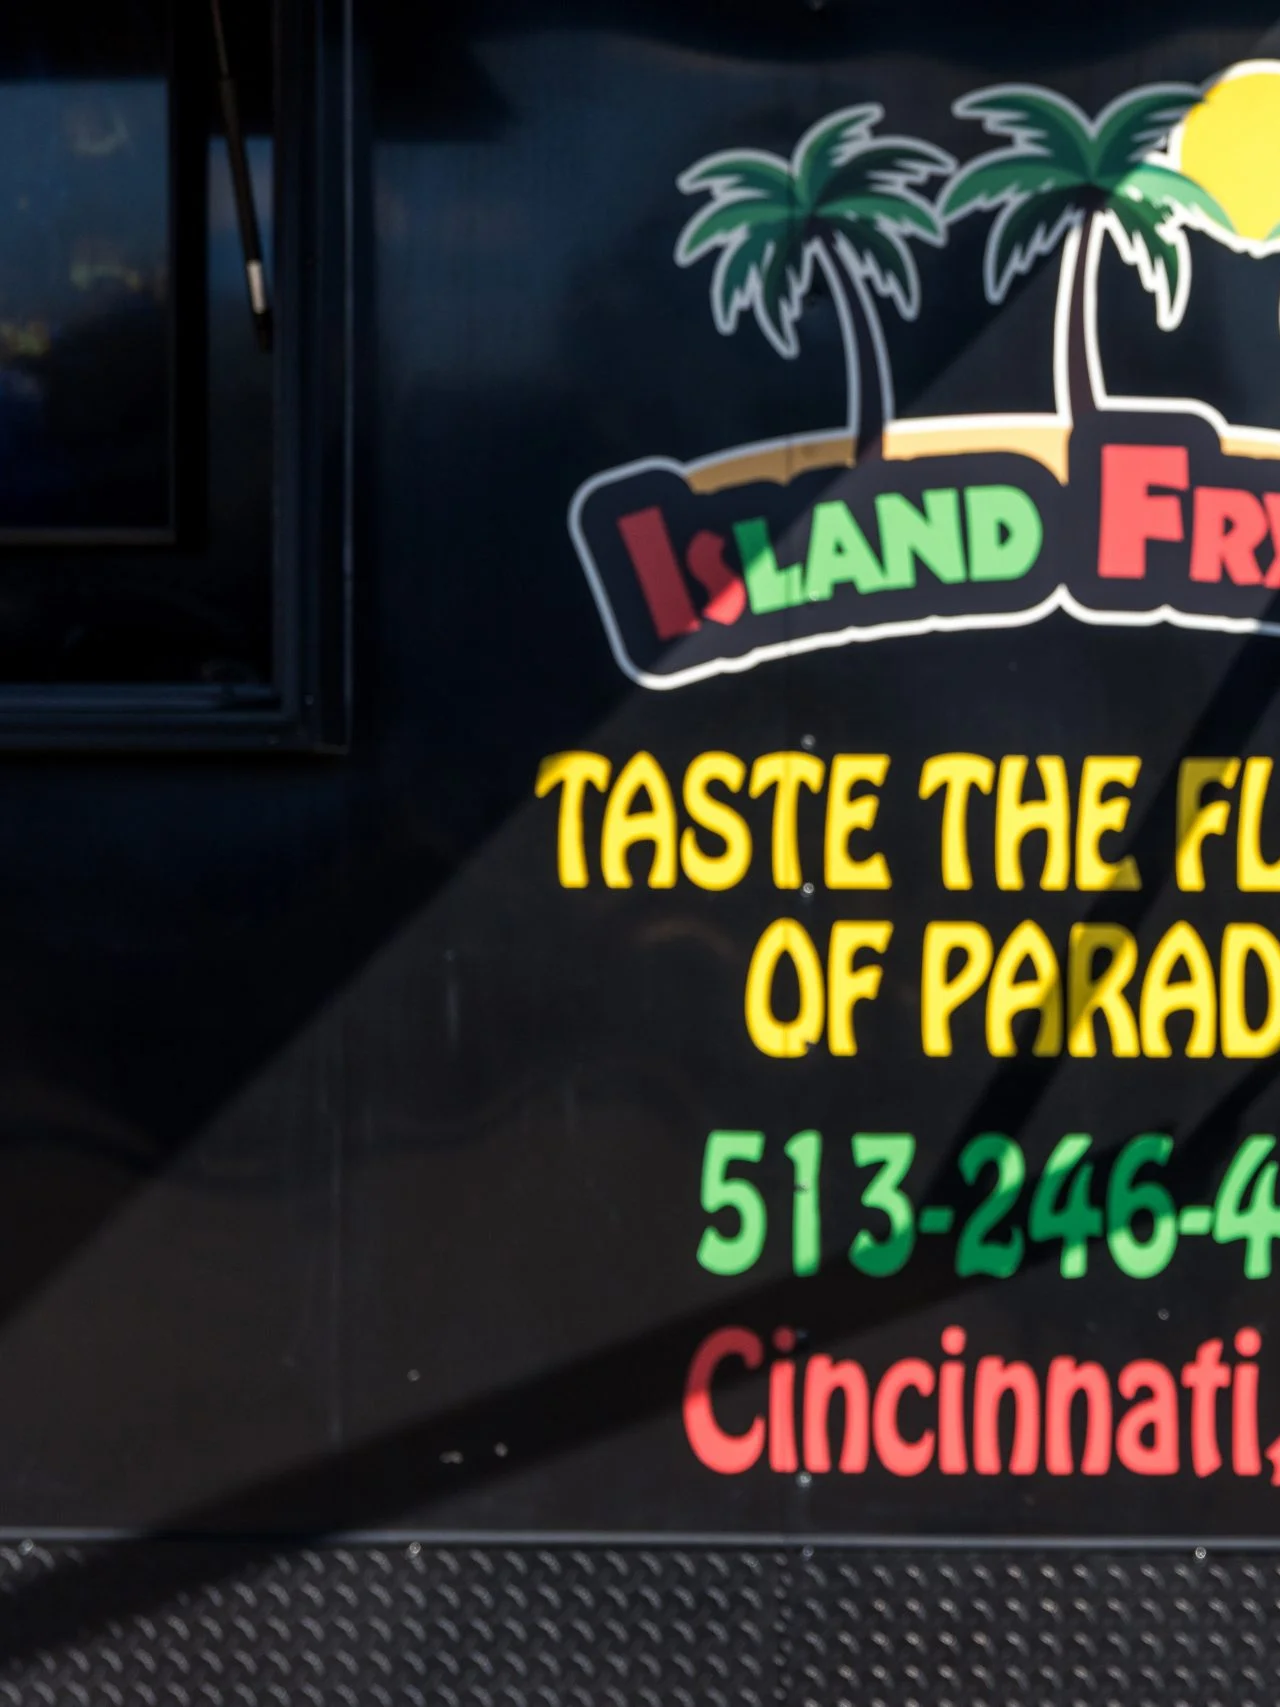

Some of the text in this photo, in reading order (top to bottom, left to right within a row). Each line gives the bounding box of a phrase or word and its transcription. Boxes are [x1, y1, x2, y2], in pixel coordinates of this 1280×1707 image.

[535, 750, 893, 892] TASTE
[918, 751, 1142, 893] THE
[744, 917, 894, 1058] OF
